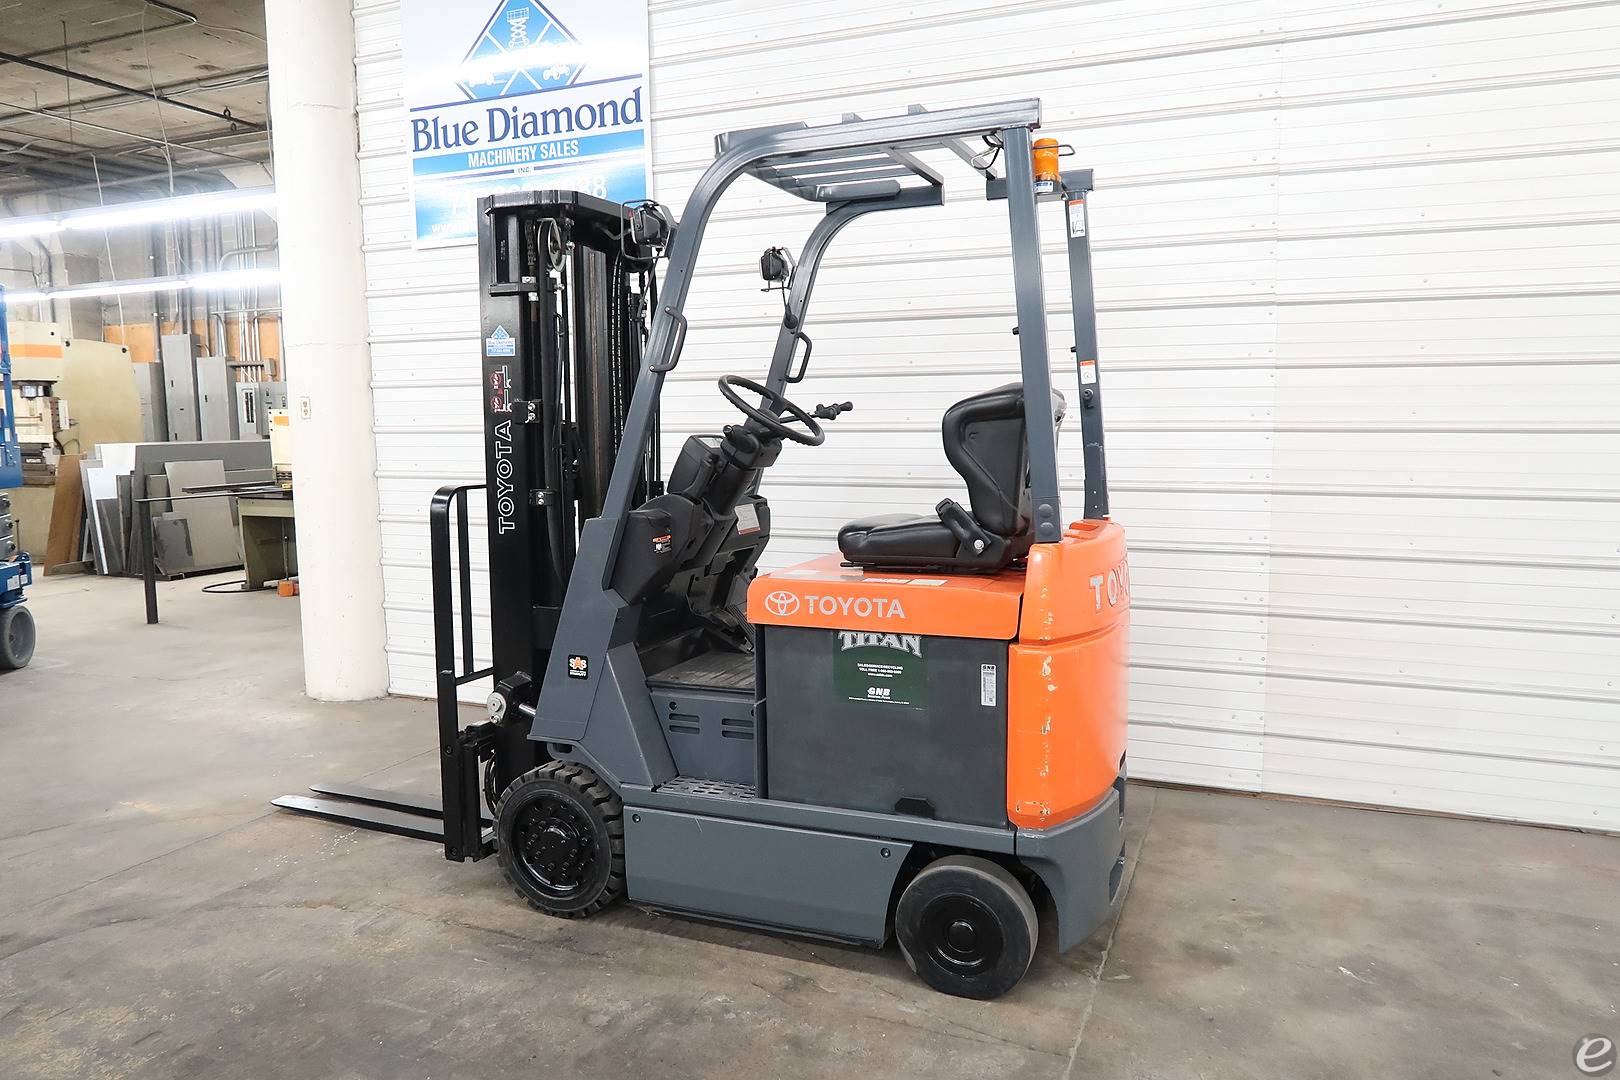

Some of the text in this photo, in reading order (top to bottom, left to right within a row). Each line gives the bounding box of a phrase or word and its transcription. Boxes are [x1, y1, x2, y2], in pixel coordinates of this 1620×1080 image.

[411, 86, 643, 153] Blue Diamond
[468, 139, 579, 168] MACHINERY SALES
[494, 419, 516, 534] TOYOTA
[1088, 560, 1129, 611] TOY
[804, 595, 906, 619] TOYOTA
[837, 631, 923, 659] TITAN
[867, 687, 890, 696] GNB
